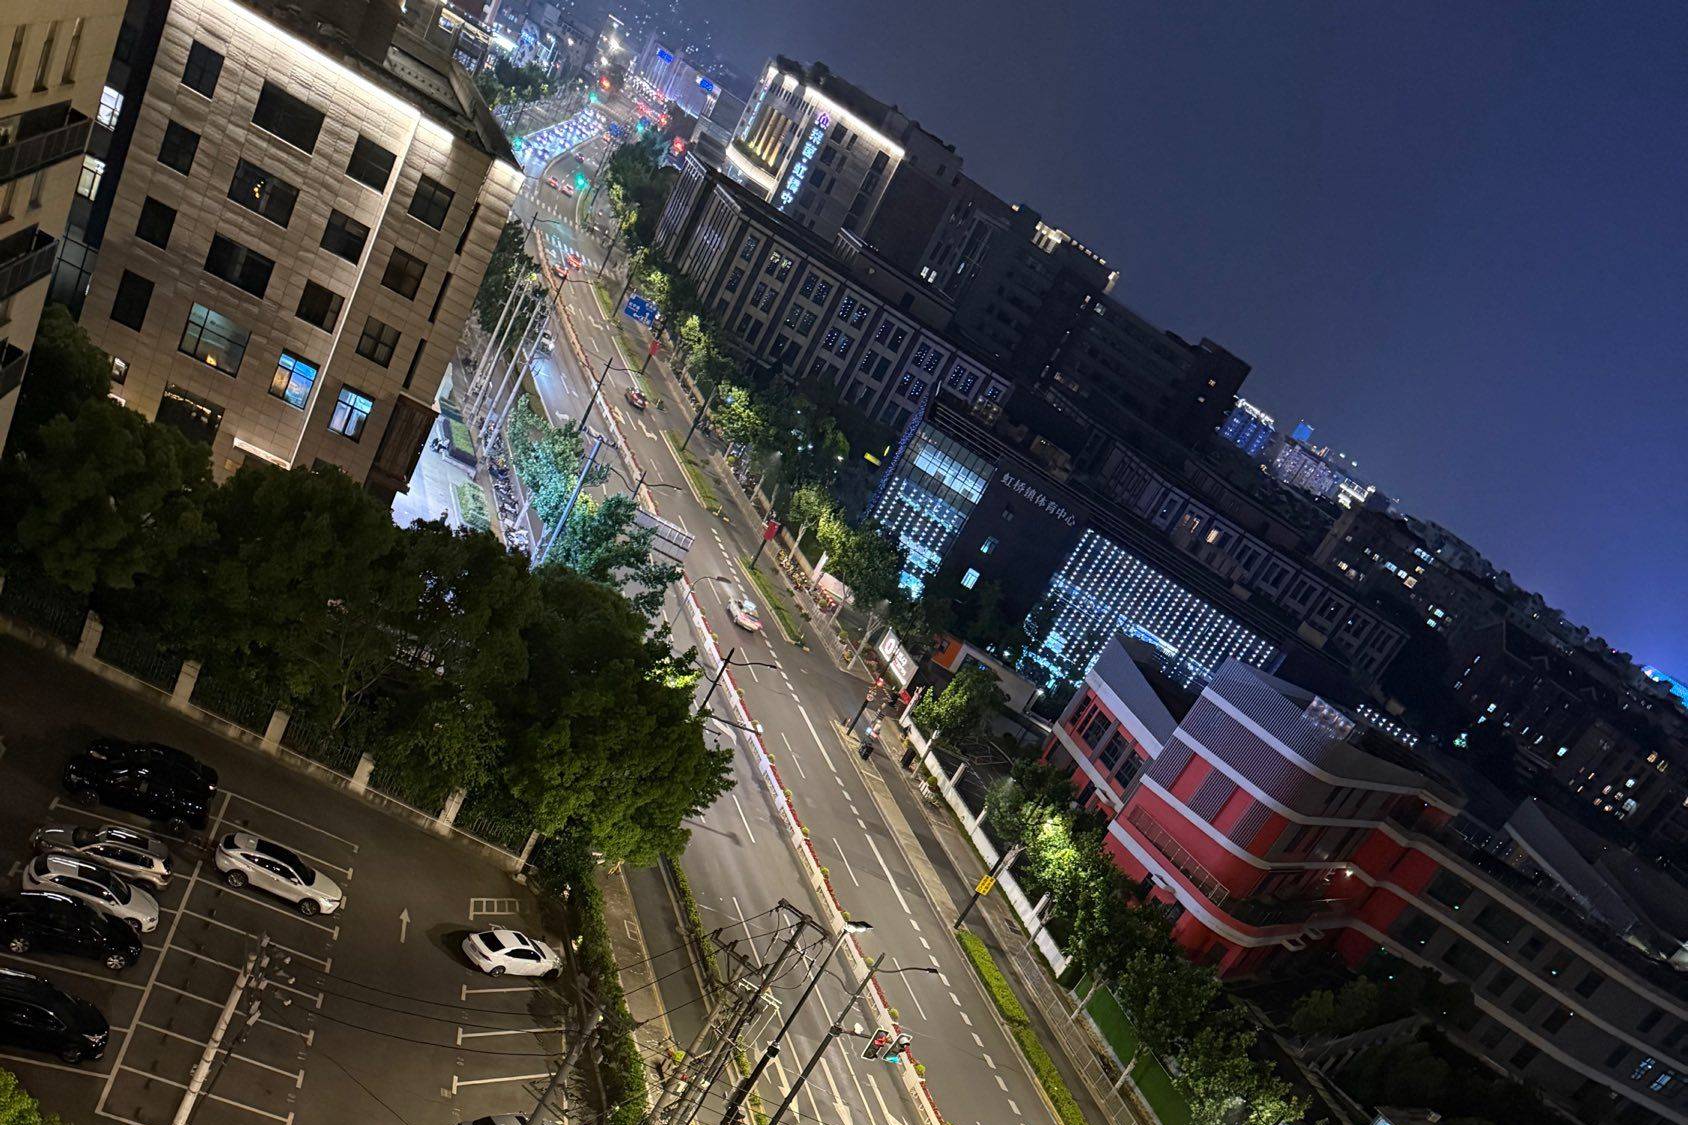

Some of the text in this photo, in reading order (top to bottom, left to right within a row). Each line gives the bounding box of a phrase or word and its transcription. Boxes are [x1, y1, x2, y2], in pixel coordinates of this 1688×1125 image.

[1000, 472, 1076, 527] 虹桥镇体育中心
